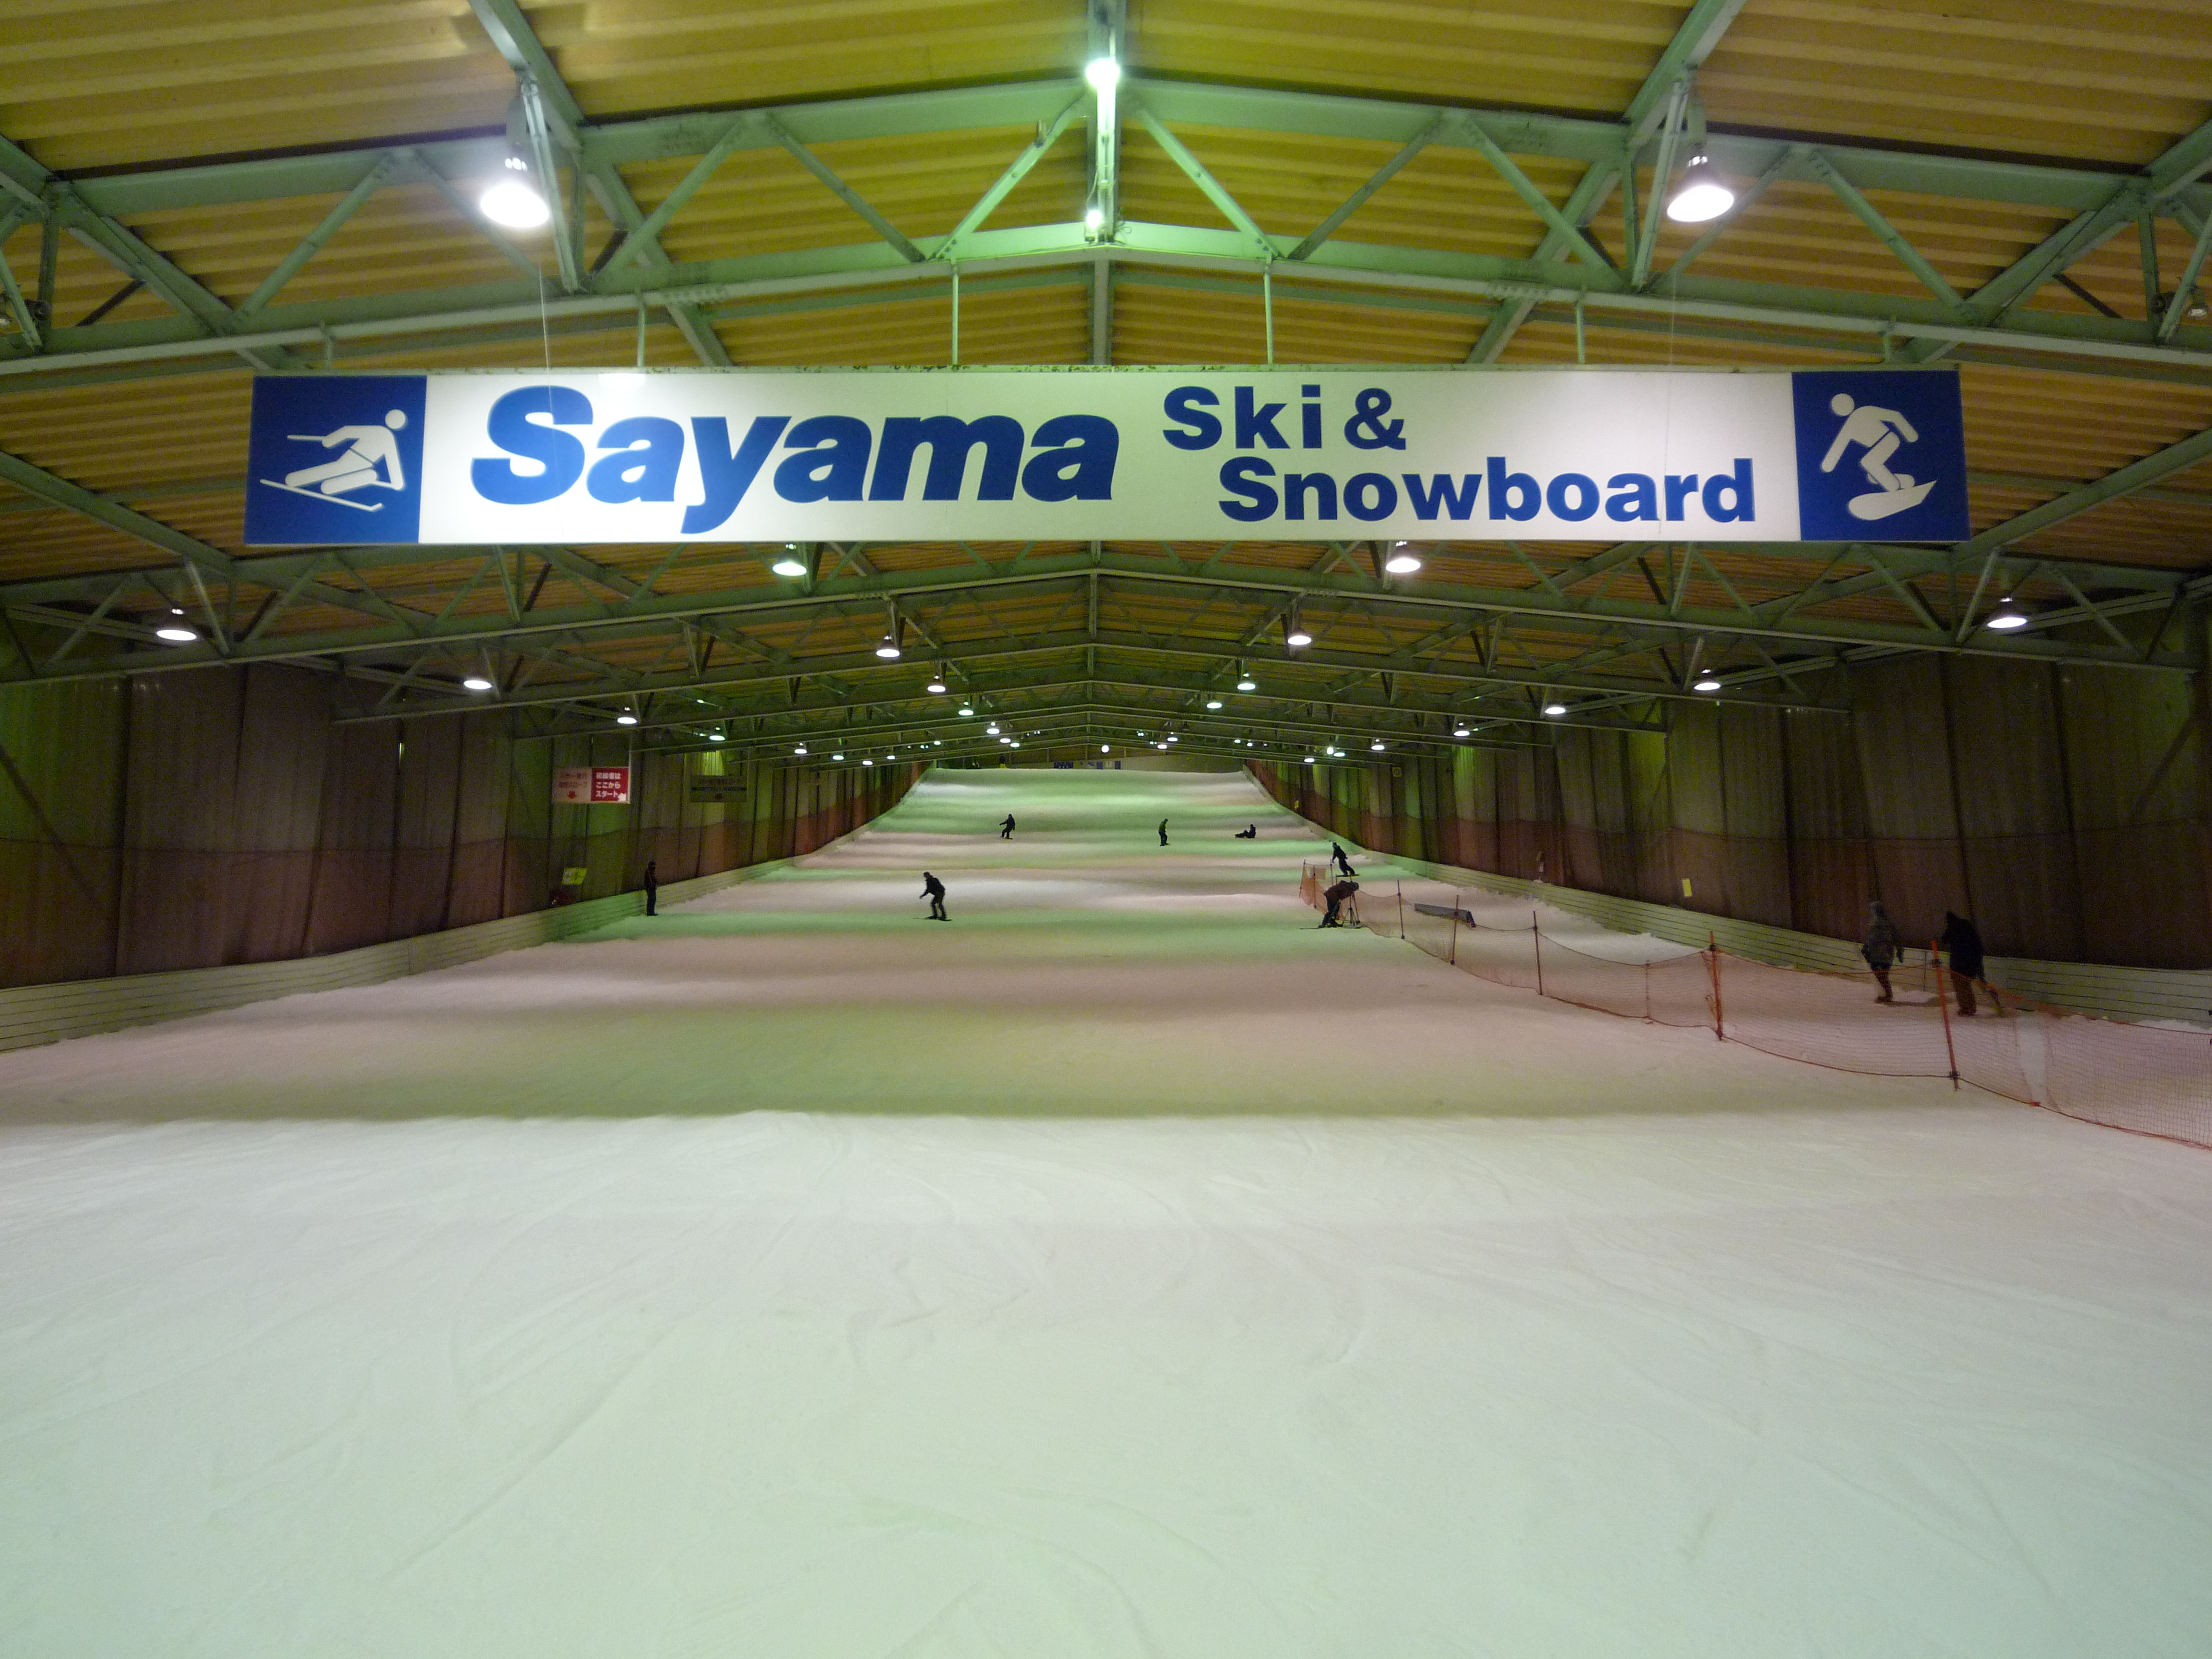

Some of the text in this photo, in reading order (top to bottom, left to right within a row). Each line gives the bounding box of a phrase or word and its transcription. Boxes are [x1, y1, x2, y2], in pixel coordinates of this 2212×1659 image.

[1163, 385, 1406, 450] Ski &
[471, 385, 1119, 534] Sayama
[1220, 456, 1755, 522] Snowboard
[596, 781, 621, 789] ここから
[596, 790, 619, 798] スタート
